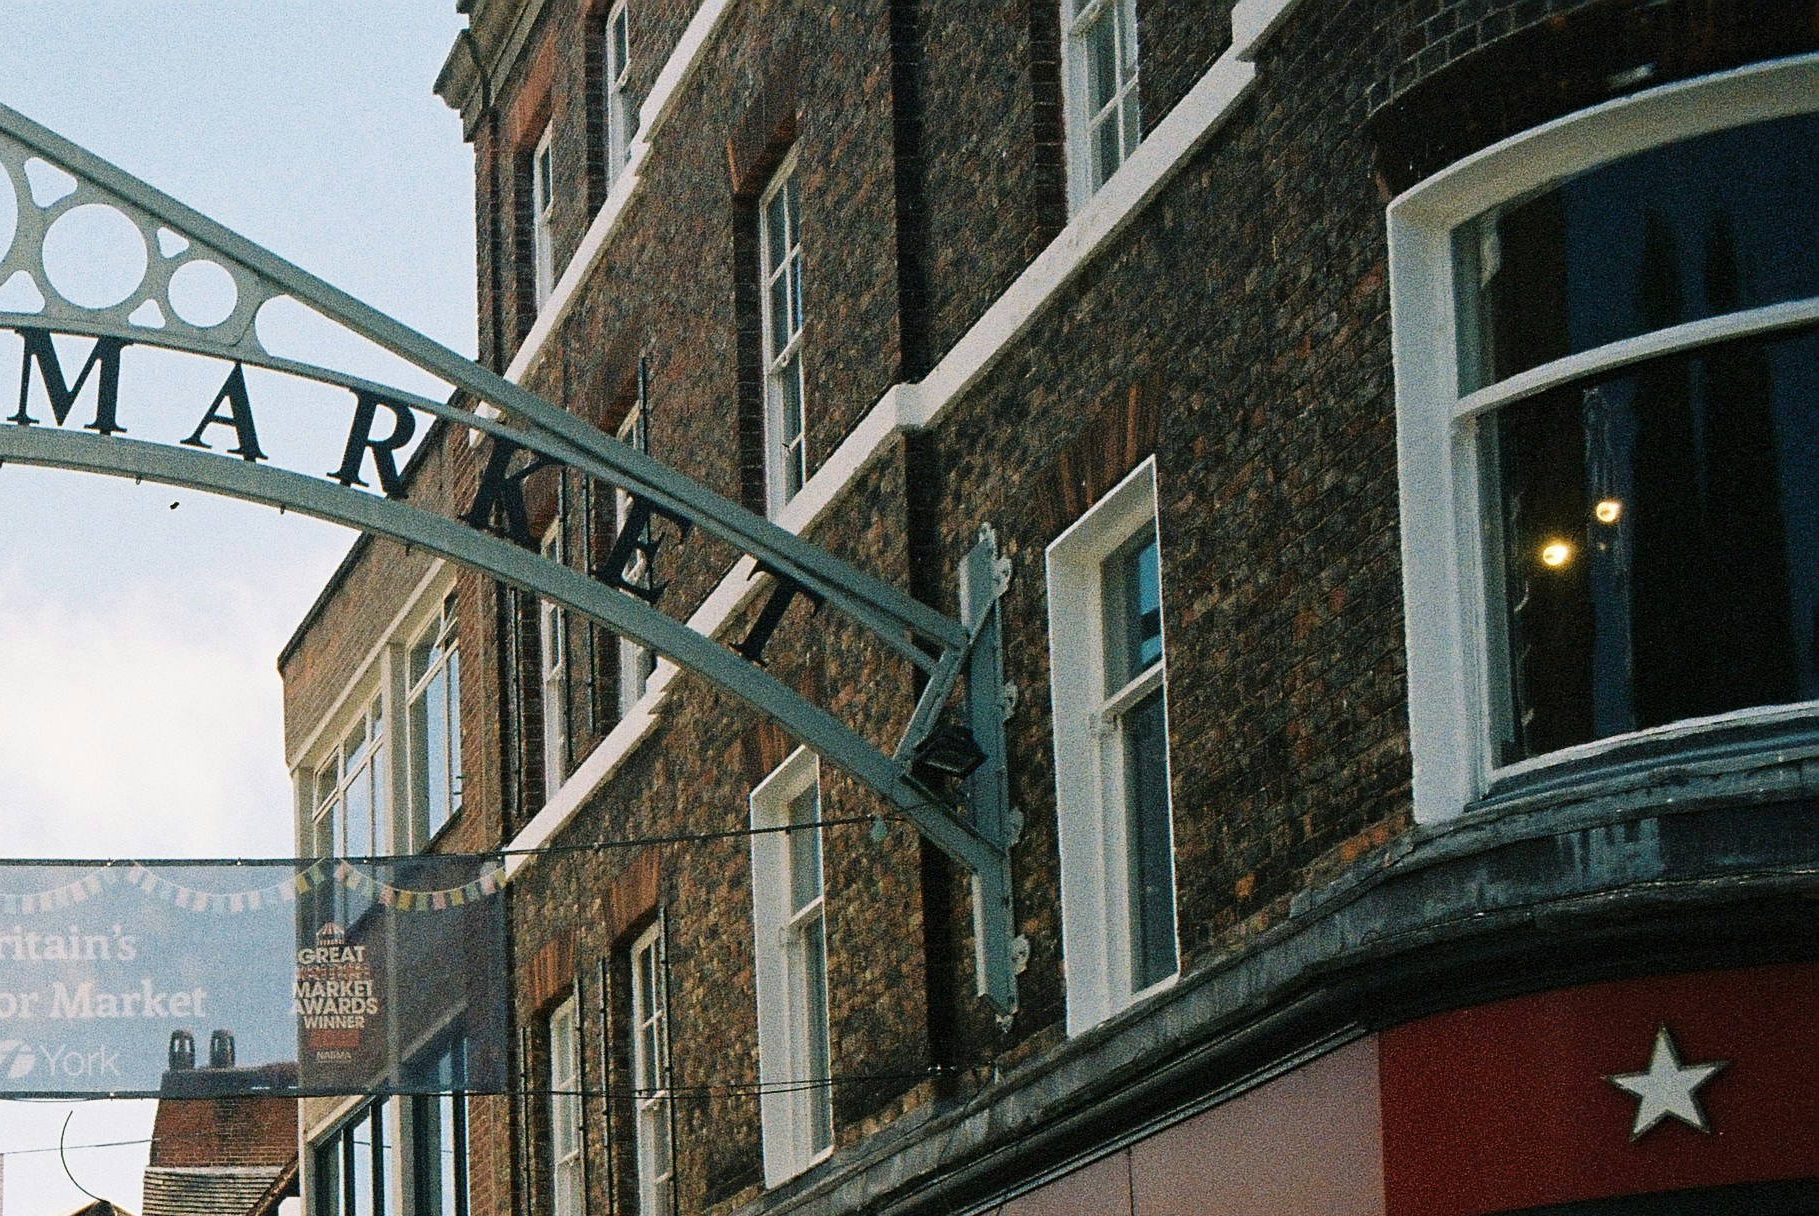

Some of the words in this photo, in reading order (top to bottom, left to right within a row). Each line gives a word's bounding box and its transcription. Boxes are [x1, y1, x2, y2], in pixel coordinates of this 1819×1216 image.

[7, 326, 822, 666] MARKET
[297, 945, 366, 966] GREAT
[49, 977, 208, 1020] Market
[291, 979, 374, 999] MARKET
[287, 997, 379, 1015] AWARDS
[303, 1014, 366, 1030] WINNER
[39, 1044, 121, 1078] York
